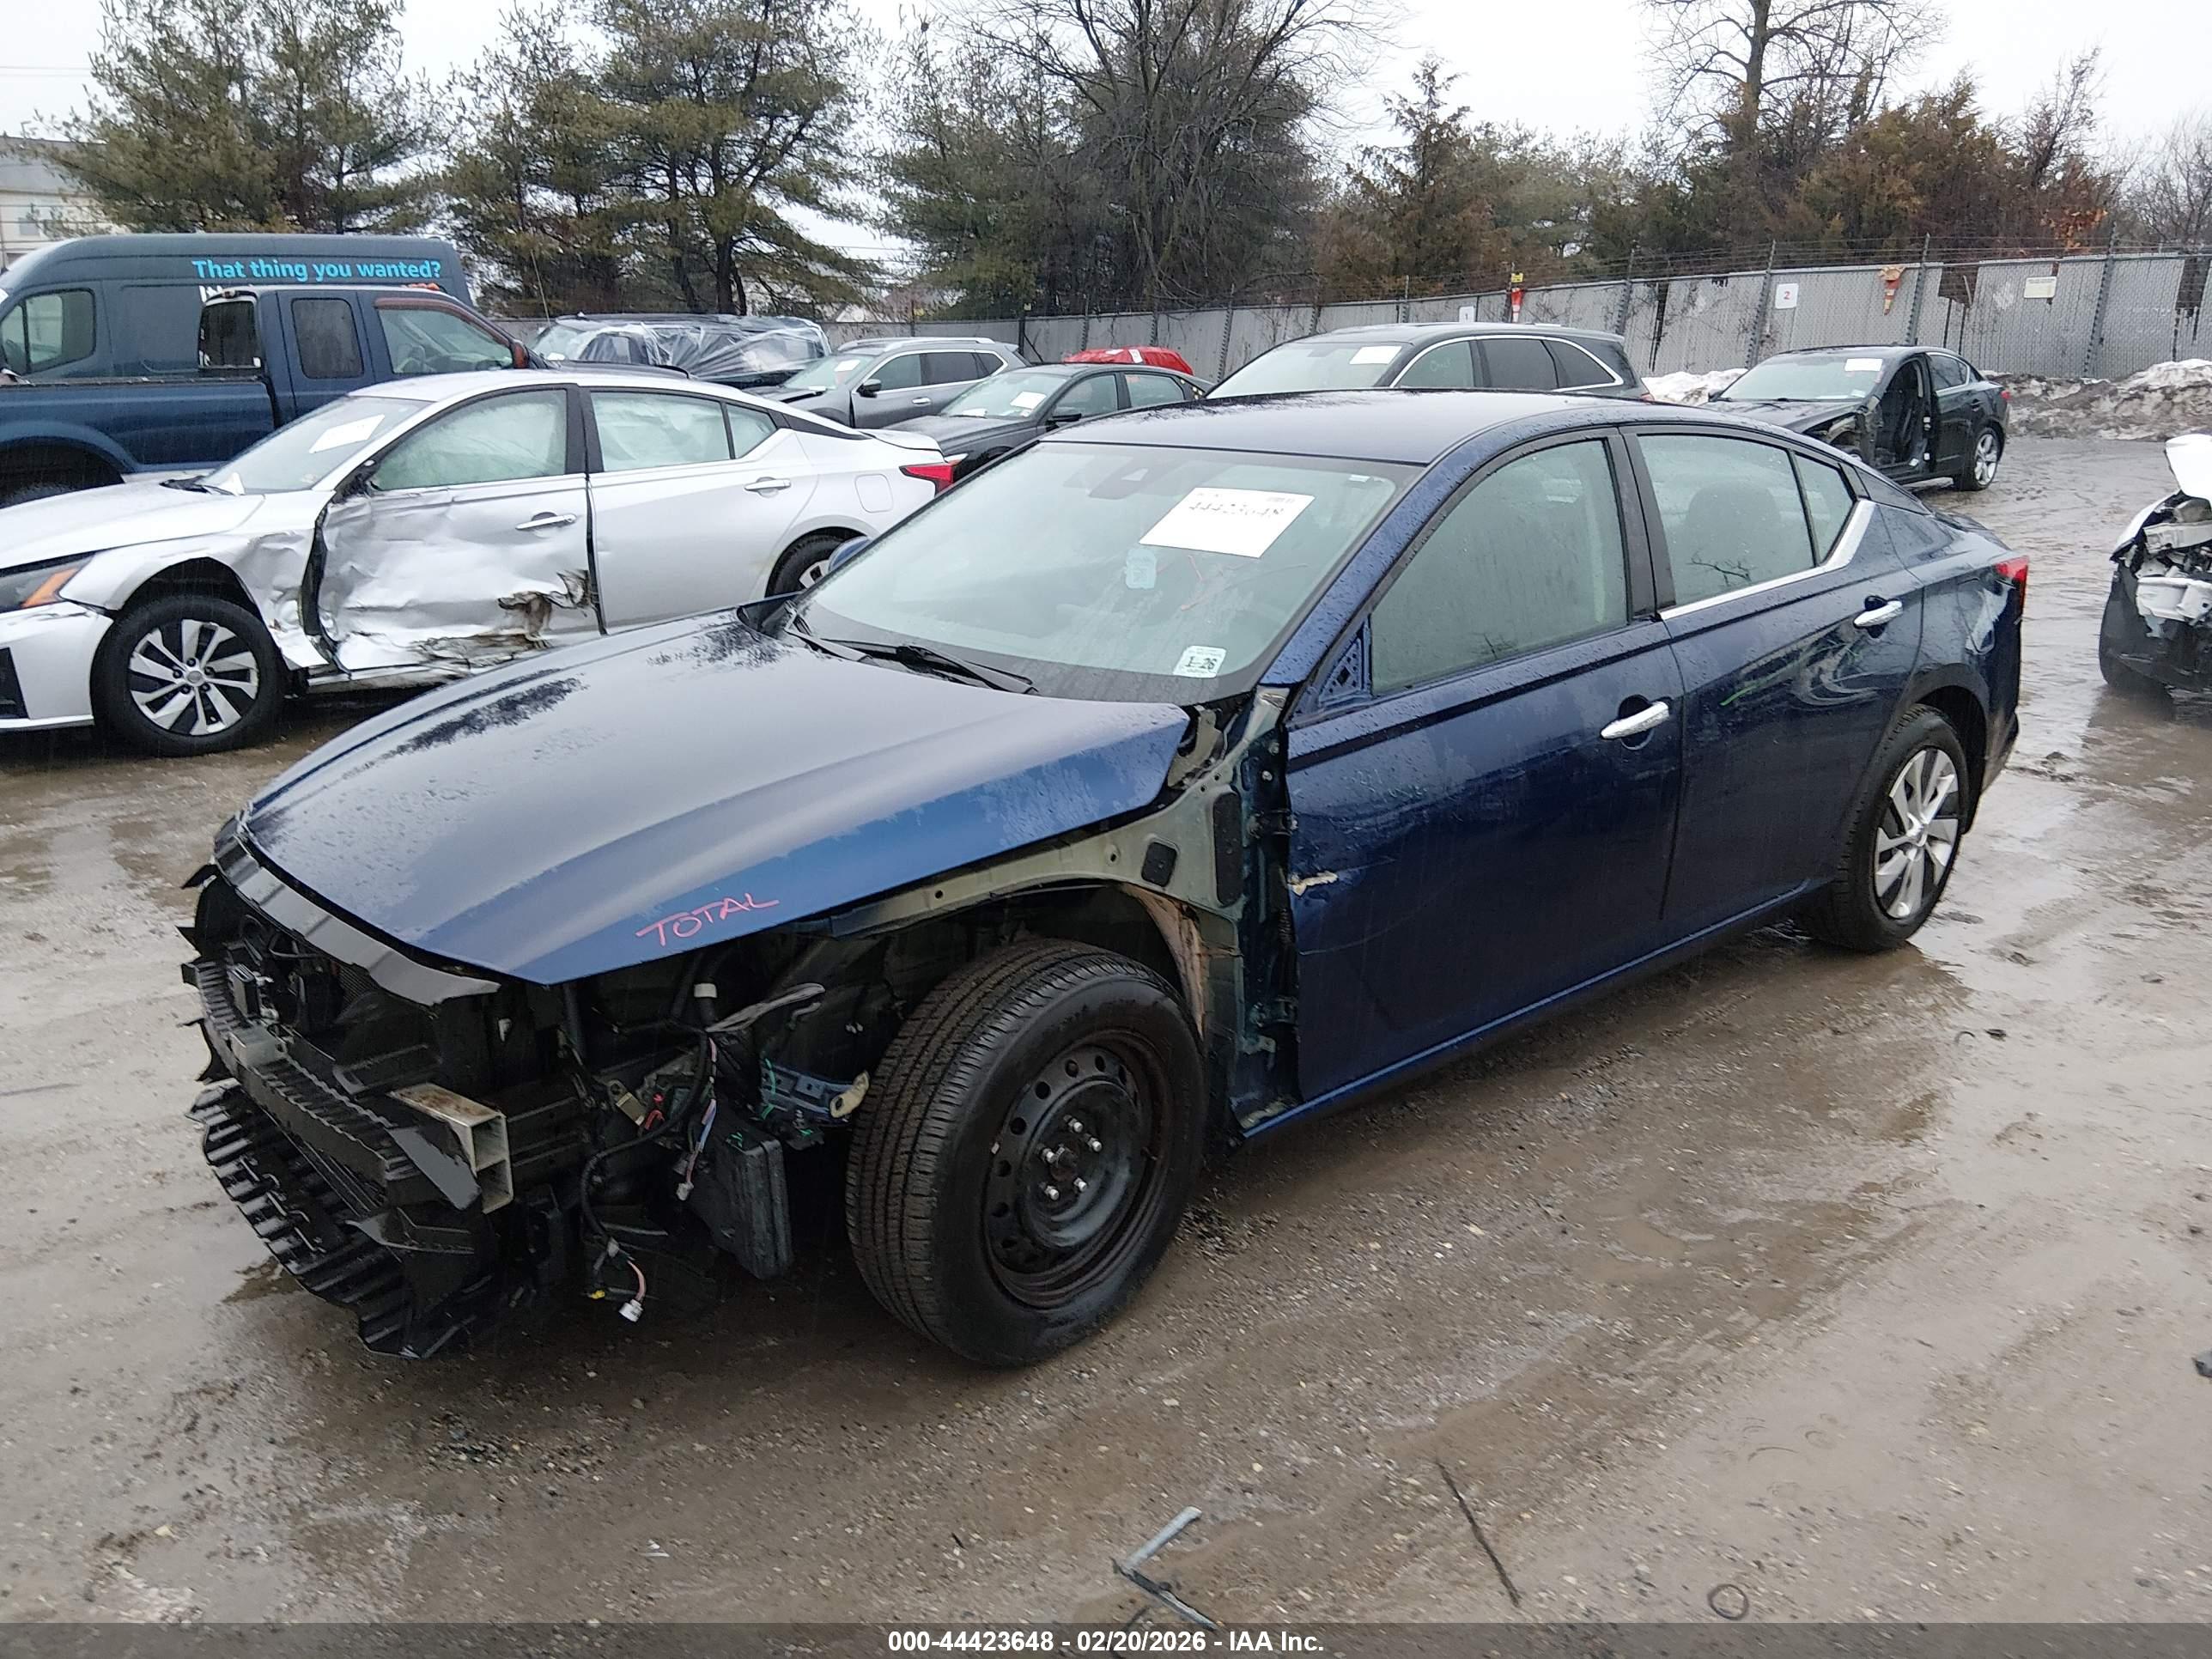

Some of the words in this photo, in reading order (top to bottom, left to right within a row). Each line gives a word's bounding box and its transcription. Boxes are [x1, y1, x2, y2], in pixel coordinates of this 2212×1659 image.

[191, 259, 246, 278] That
[249, 258, 308, 282] thing
[312, 263, 352, 283] you
[356, 259, 441, 278] wanted?
[1784, 290, 1791, 301] 2
[635, 892, 780, 947] TOTAL
